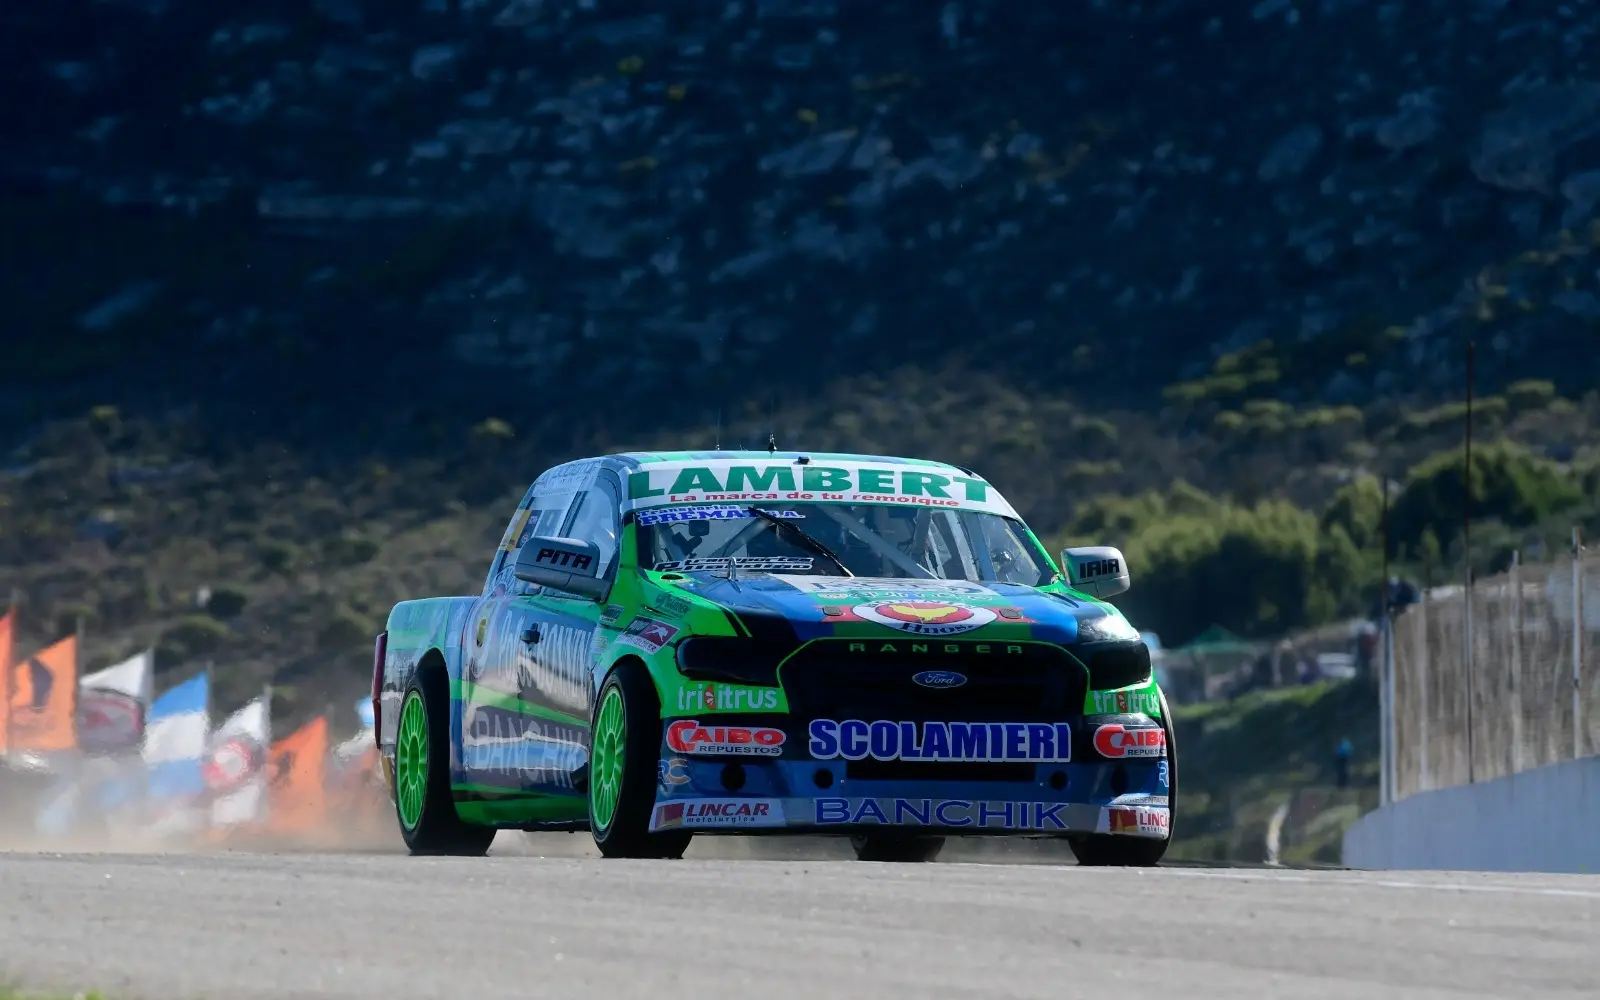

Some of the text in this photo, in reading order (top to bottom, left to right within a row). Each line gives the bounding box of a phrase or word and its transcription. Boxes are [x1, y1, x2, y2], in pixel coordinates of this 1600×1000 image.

[629, 466, 990, 503] LAMBERT
[671, 491, 960, 507] La marca de tu remolque
[536, 548, 593, 570] PITA
[901, 622, 974, 636] Hnos.
[849, 643, 1022, 654] RANGER
[924, 673, 955, 685] Ford
[667, 720, 786, 753] CAIBO
[809, 719, 1071, 762] SCOLAMIERI
[699, 744, 780, 755] REPUESTOS
[686, 802, 770, 817] LINCAR
[813, 797, 1070, 830] BANCHIK
